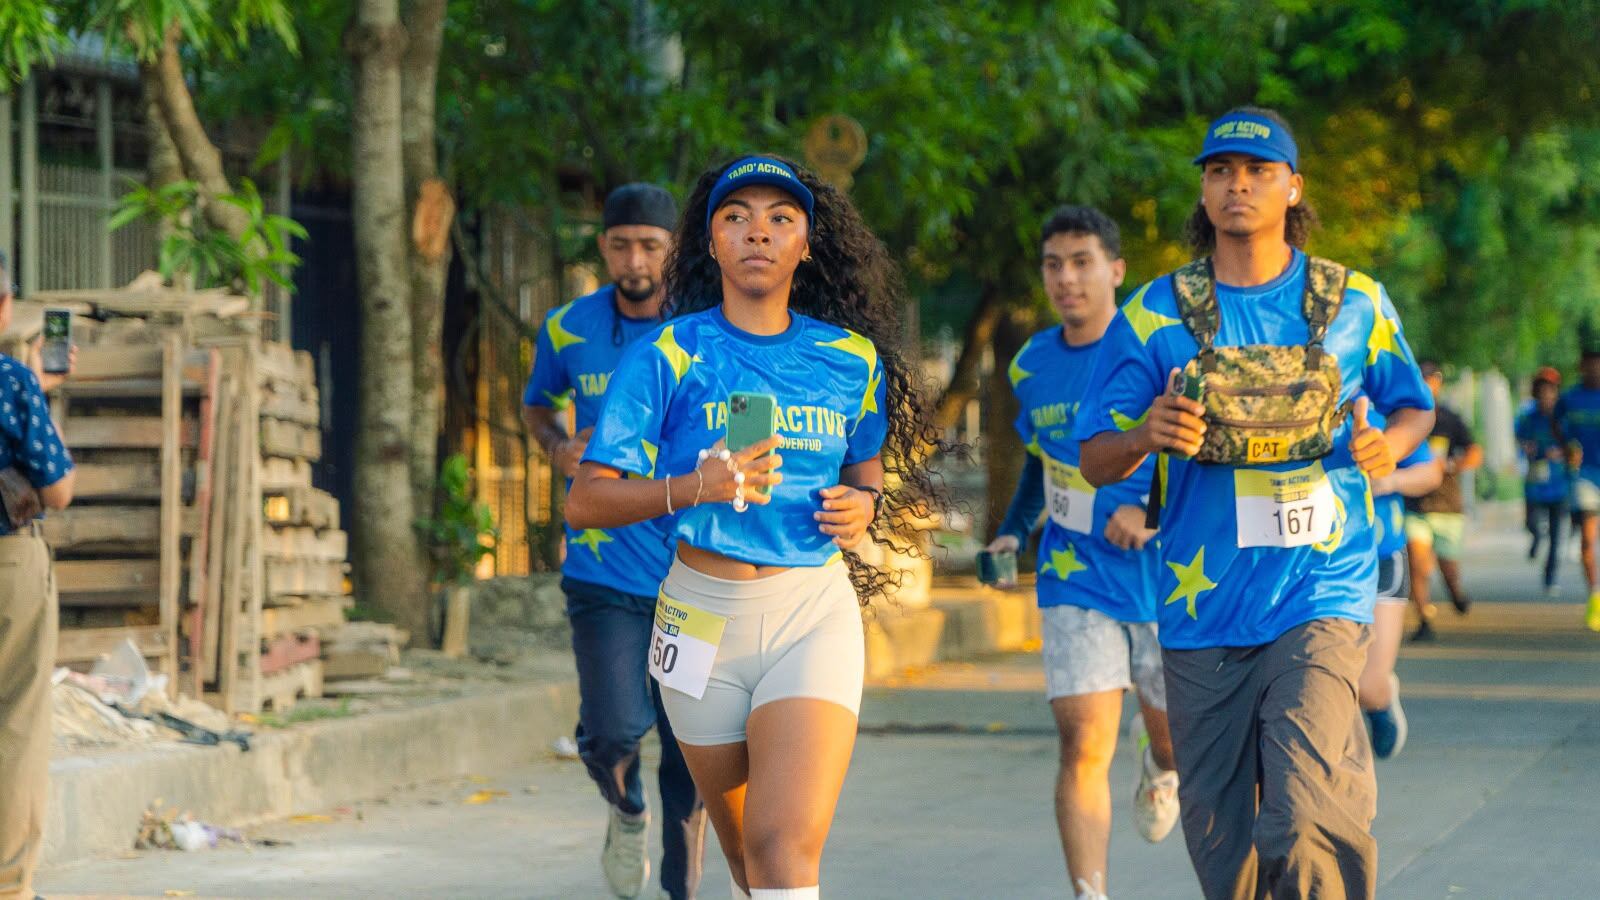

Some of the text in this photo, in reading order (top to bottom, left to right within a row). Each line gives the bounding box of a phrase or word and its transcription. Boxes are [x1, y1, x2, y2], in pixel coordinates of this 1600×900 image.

[728, 163, 757, 180] TAMO'
[577, 373, 612, 397] TAM
[702, 401, 847, 438] TA ACTIVO
[778, 437, 822, 452] OVENTUD
[1252, 442, 1280, 458] CAT
[1272, 505, 1315, 536] 167
[664, 604, 688, 621] ACTIVO
